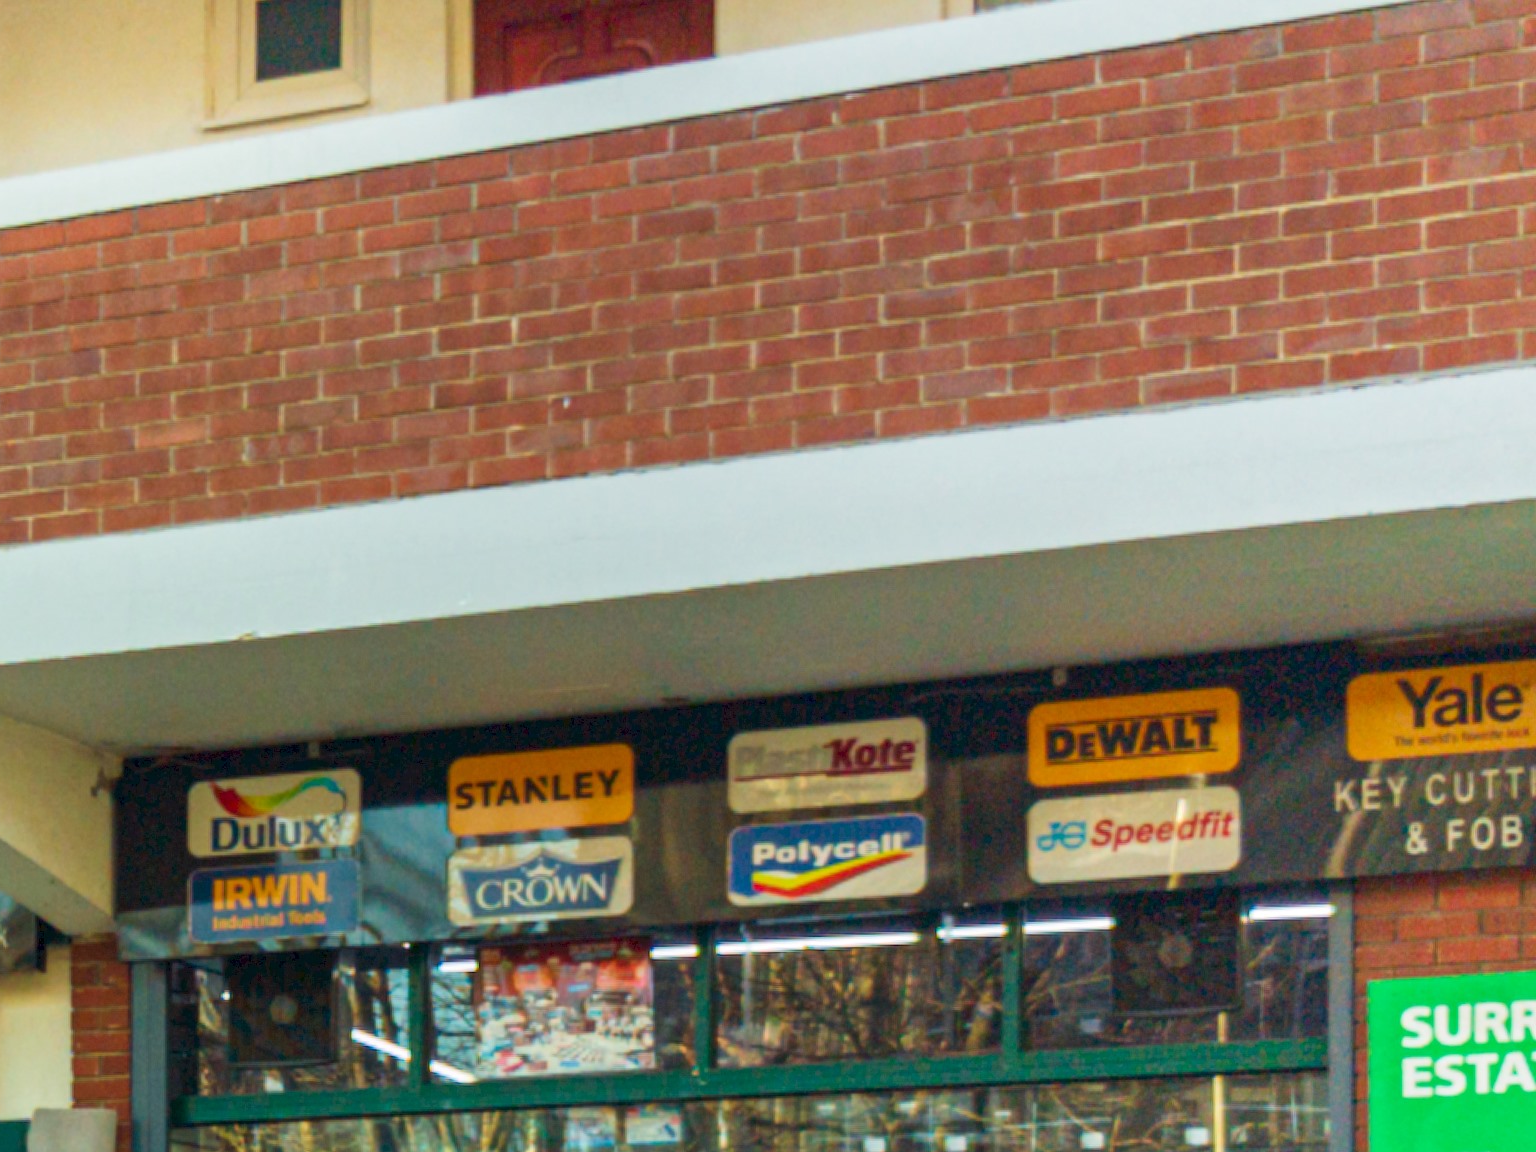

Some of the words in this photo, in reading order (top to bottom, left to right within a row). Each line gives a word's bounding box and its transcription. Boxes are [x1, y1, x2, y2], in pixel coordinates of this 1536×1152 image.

[1397, 672, 1524, 728] Yale
[455, 769, 621, 811] STANLEY
[1333, 776, 1408, 813] KEY
[212, 816, 326, 851] Dulux
[752, 830, 905, 868] Polycell
[1090, 810, 1234, 852] Speedfit
[1405, 821, 1428, 855] &
[1446, 814, 1524, 852] FOB
[212, 870, 328, 911] IRWIN
[475, 872, 609, 912] CROWN
[212, 912, 284, 932] Industrial
[288, 909, 327, 926] Tools
[1400, 999, 1536, 1049] SURR
[1401, 1051, 1536, 1098] ESTA
